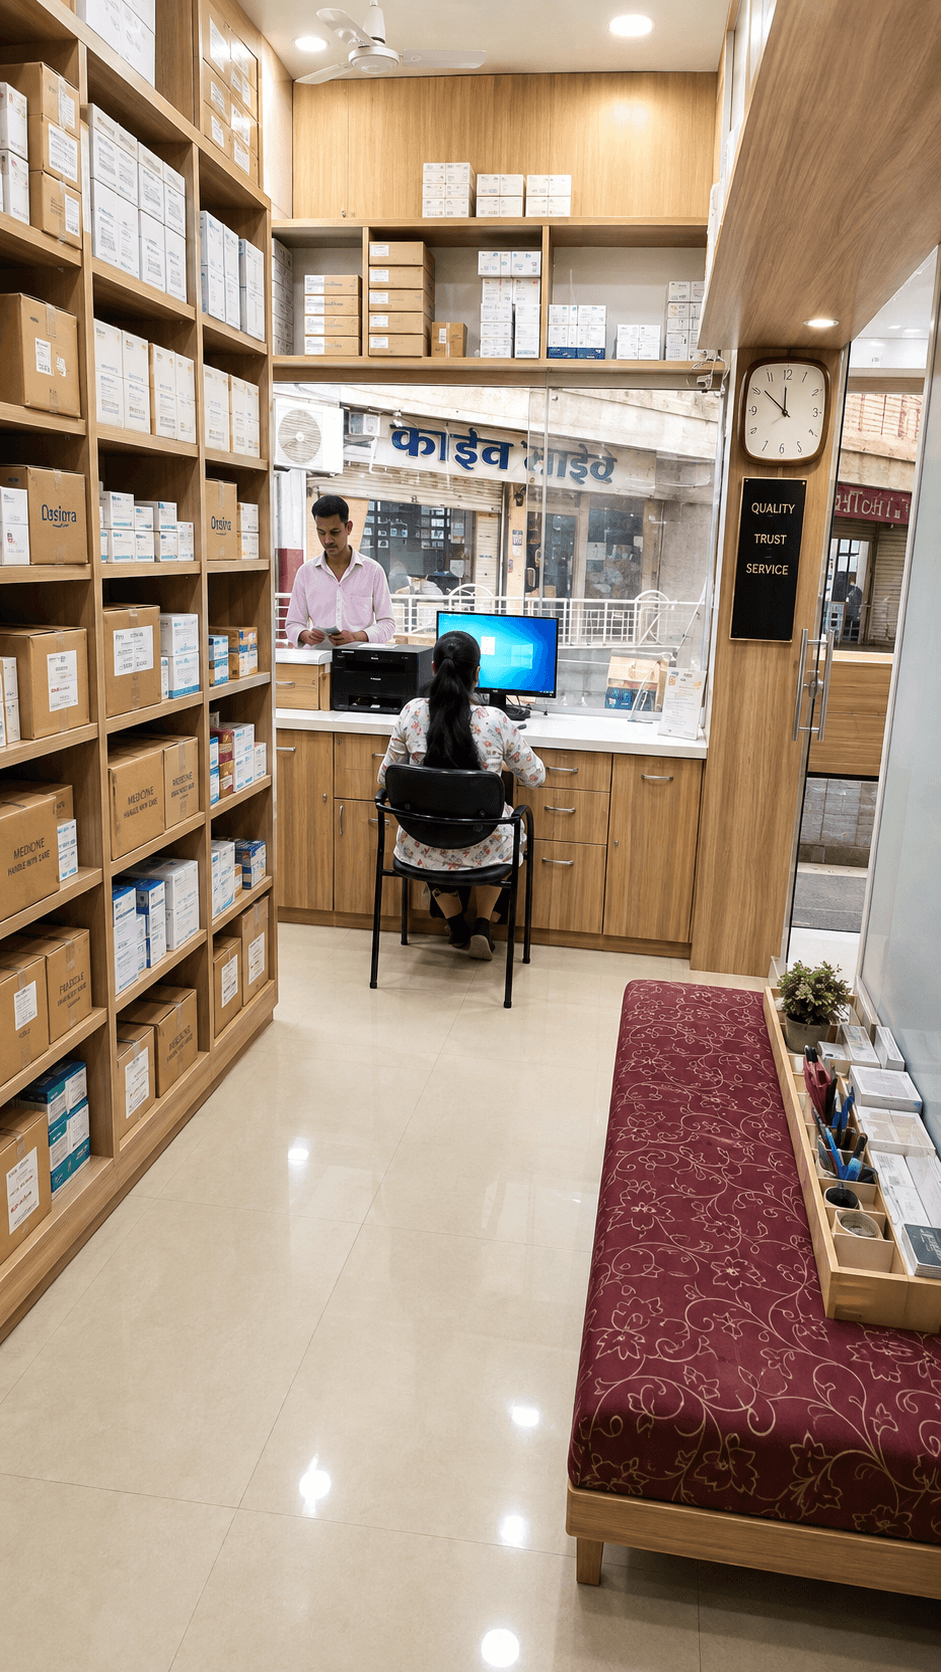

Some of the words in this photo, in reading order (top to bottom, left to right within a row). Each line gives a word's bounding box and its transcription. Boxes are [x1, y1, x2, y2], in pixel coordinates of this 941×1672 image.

[766, 372, 774, 382] 11
[784, 369, 792, 380] 12
[812, 388, 819, 396] 2
[751, 406, 758, 416] 9
[812, 407, 818, 417] 3
[779, 443, 785, 454] 6
[751, 502, 795, 515] QUALITY
[754, 533, 787, 545] TRUST
[746, 563, 789, 575] SERVICE
